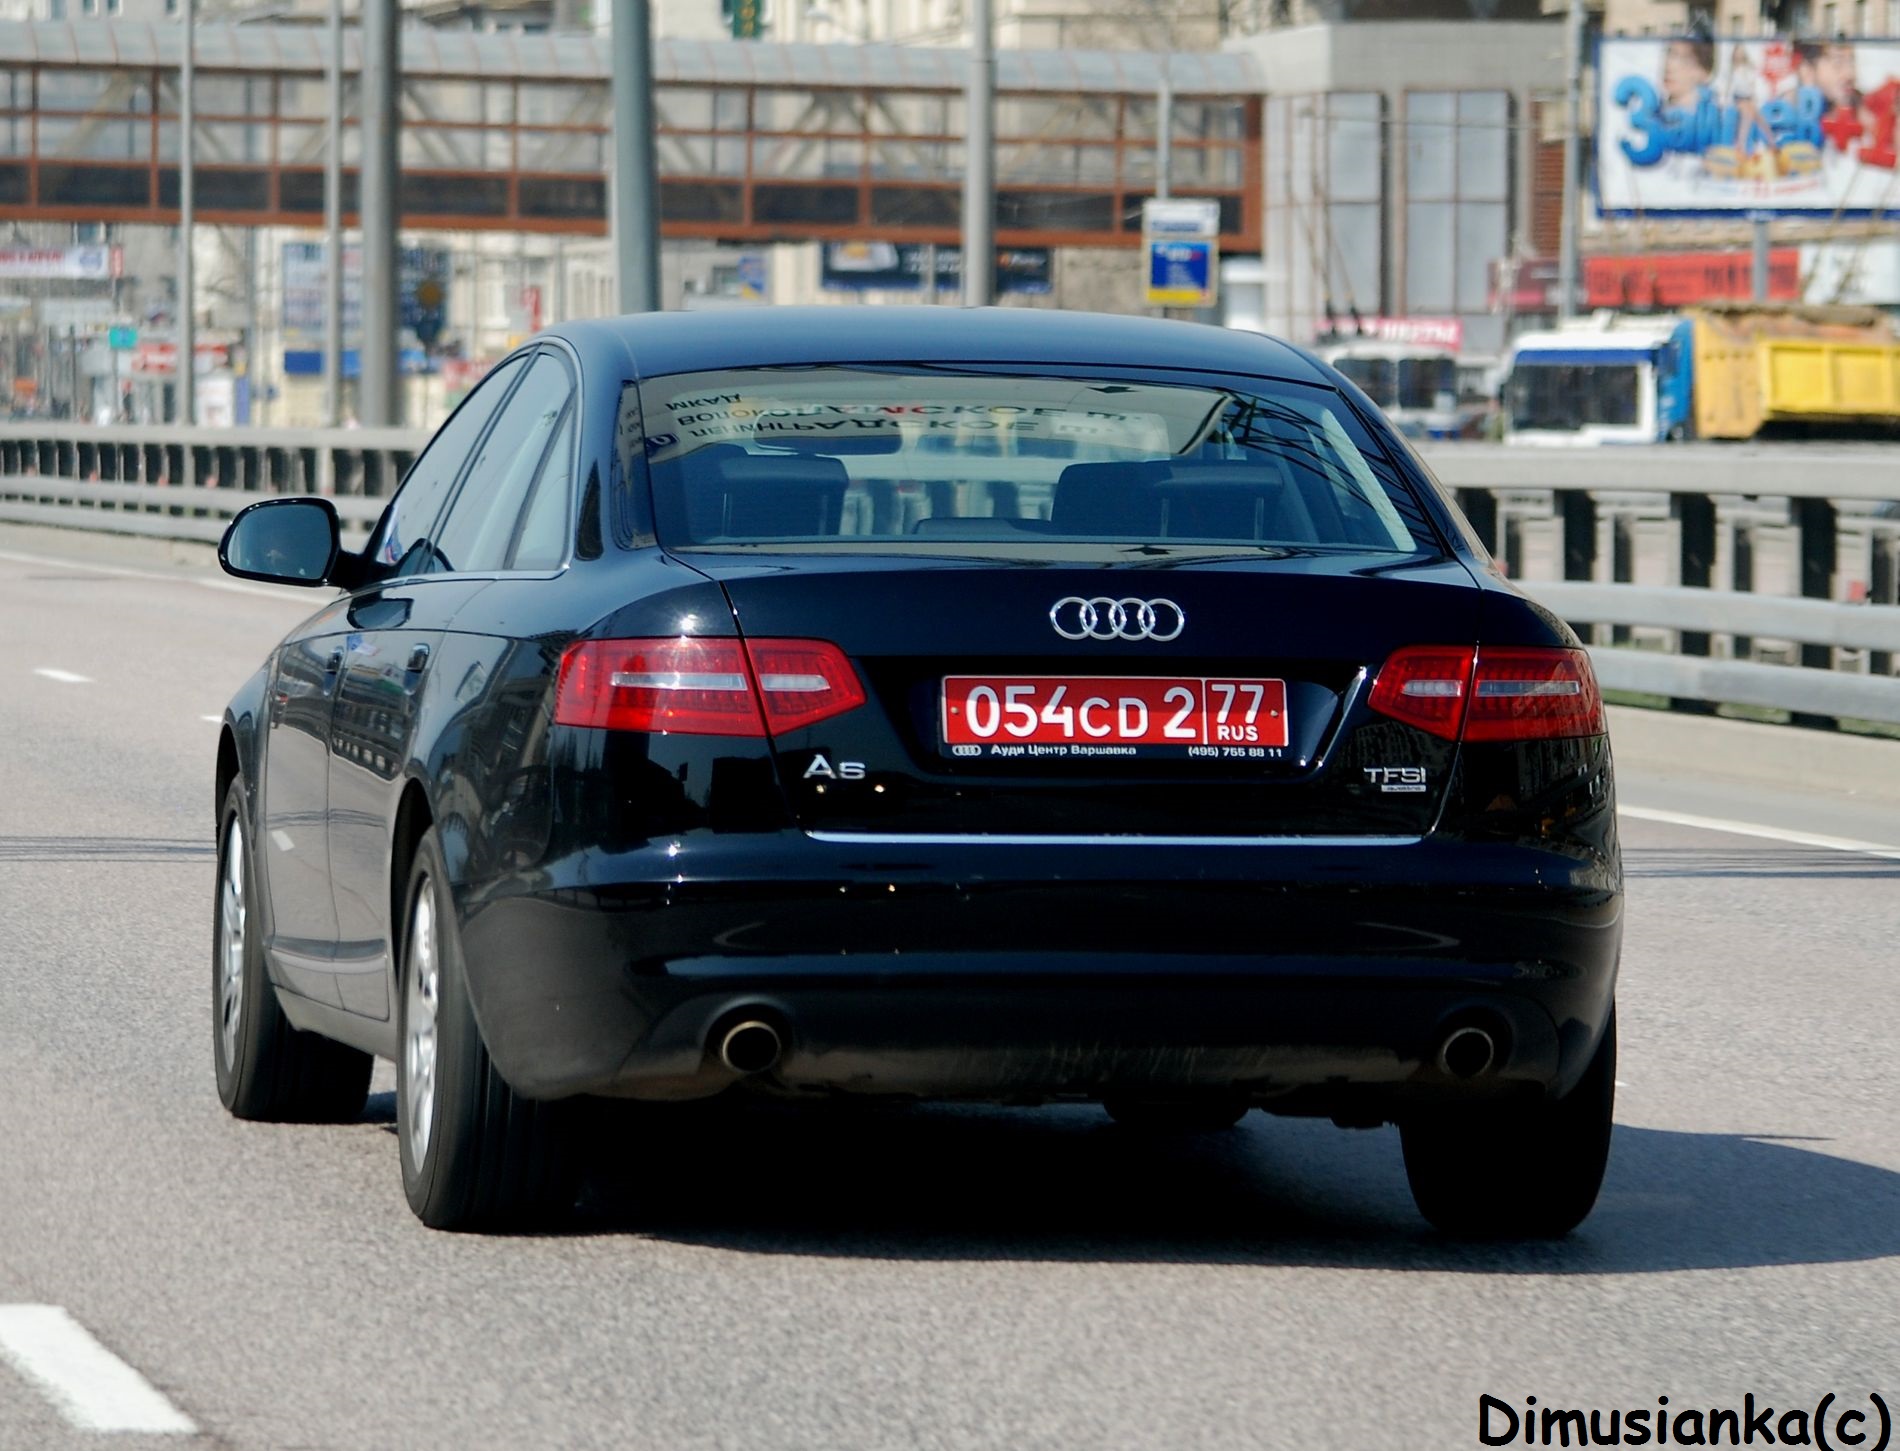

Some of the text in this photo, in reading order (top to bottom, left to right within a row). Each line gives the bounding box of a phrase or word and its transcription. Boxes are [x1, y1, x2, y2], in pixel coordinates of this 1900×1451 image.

[1211, 684, 1265, 724] 77
[1217, 725, 1259, 742] RUS
[990, 745, 1283, 758] Ауди Центр Варшавка (495) 755 88 11
[1363, 767, 1427, 784] TFSI
